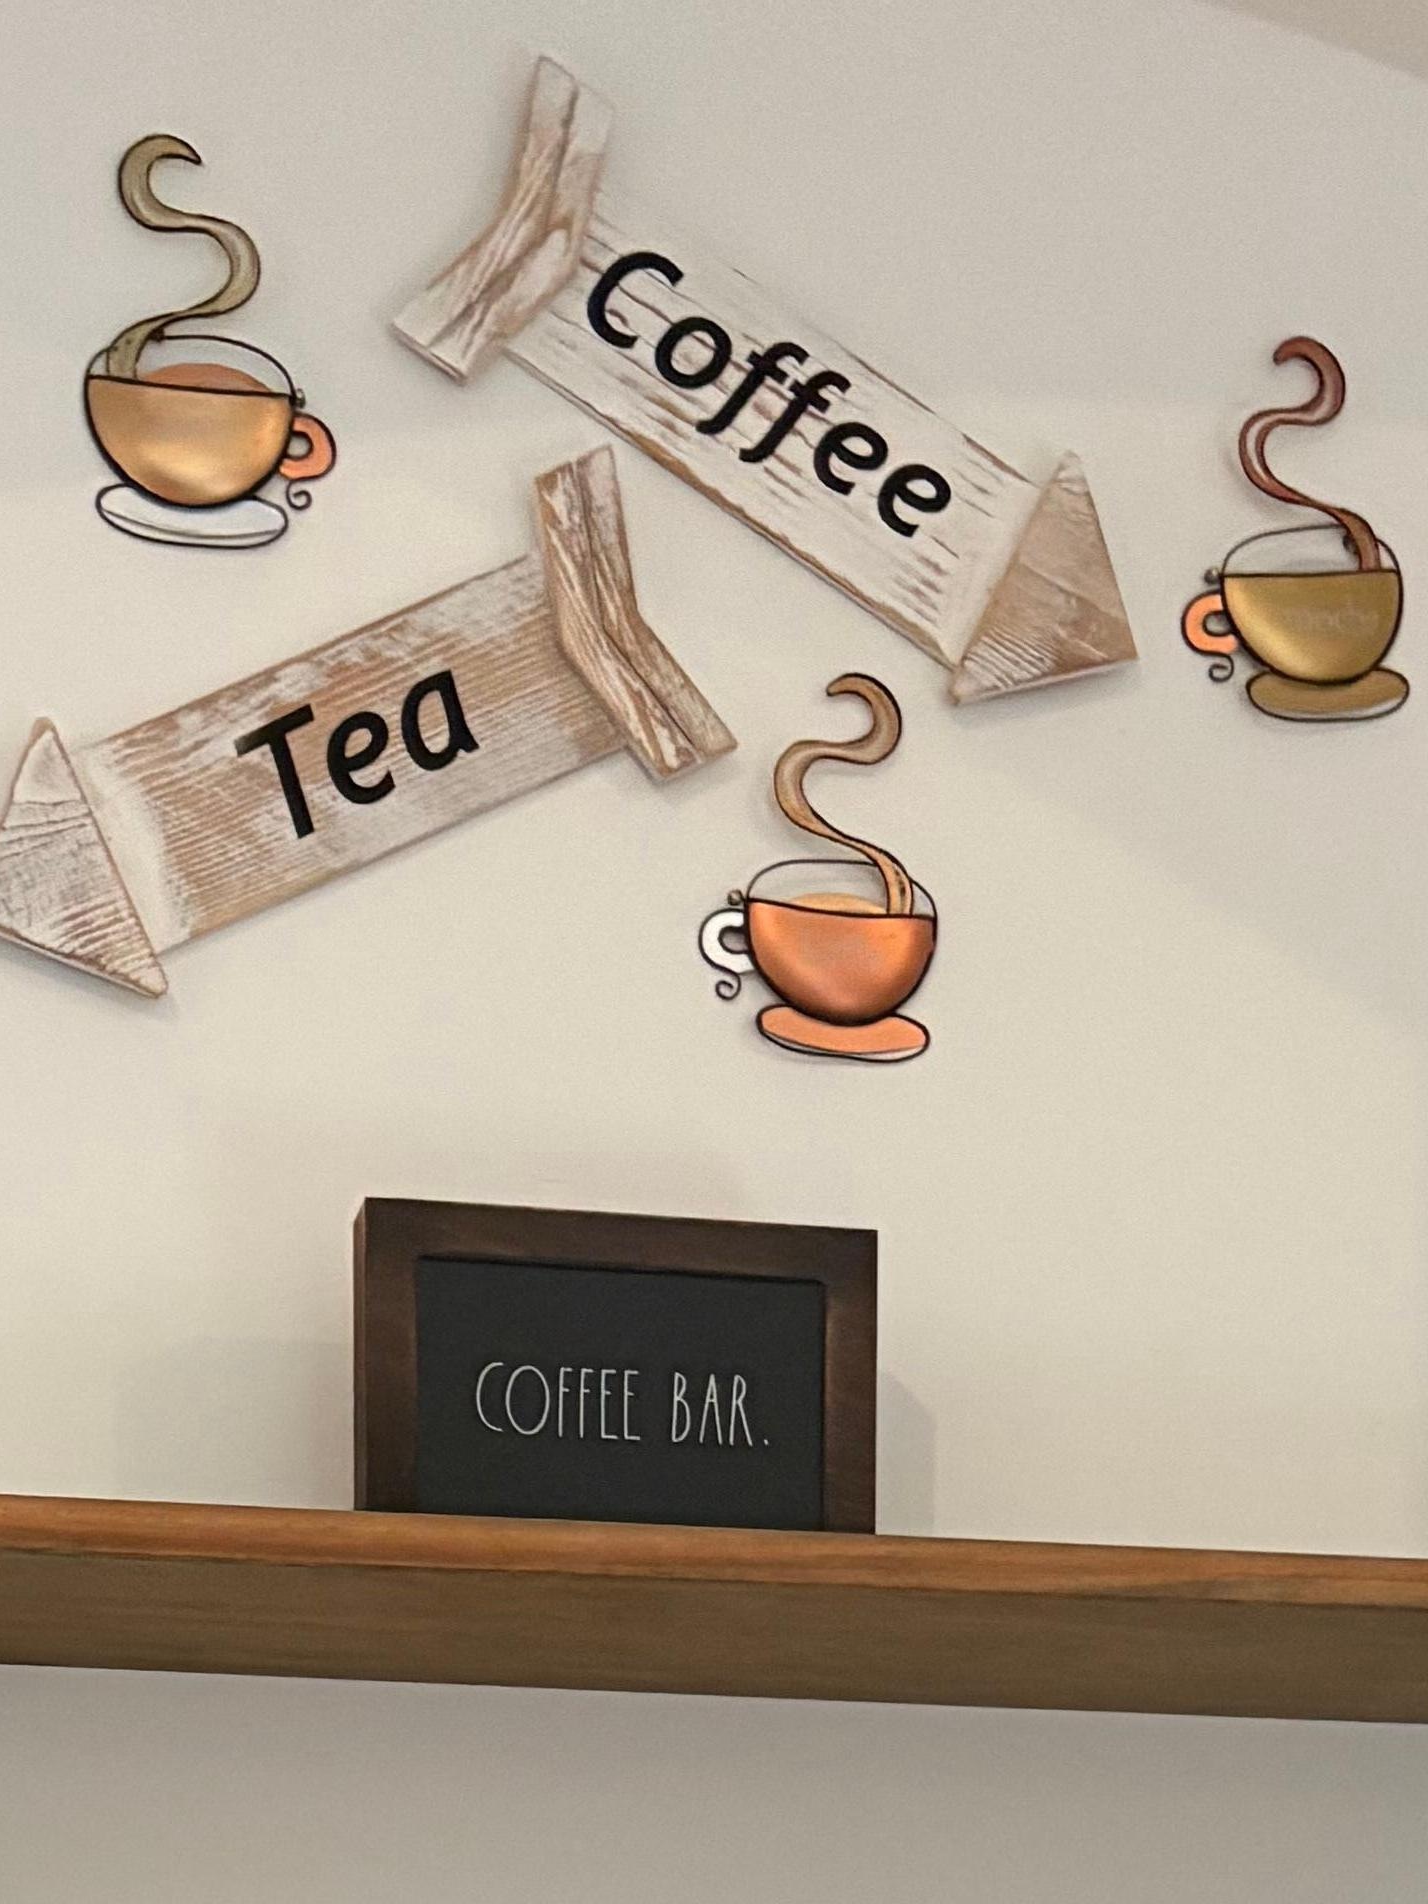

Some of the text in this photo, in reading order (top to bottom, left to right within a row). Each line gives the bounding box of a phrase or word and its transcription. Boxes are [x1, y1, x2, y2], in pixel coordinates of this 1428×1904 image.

[585, 249, 953, 539] Coffee
[236, 668, 480, 840] Tea
[475, 1361, 770, 1447] COFFEE BAR.
